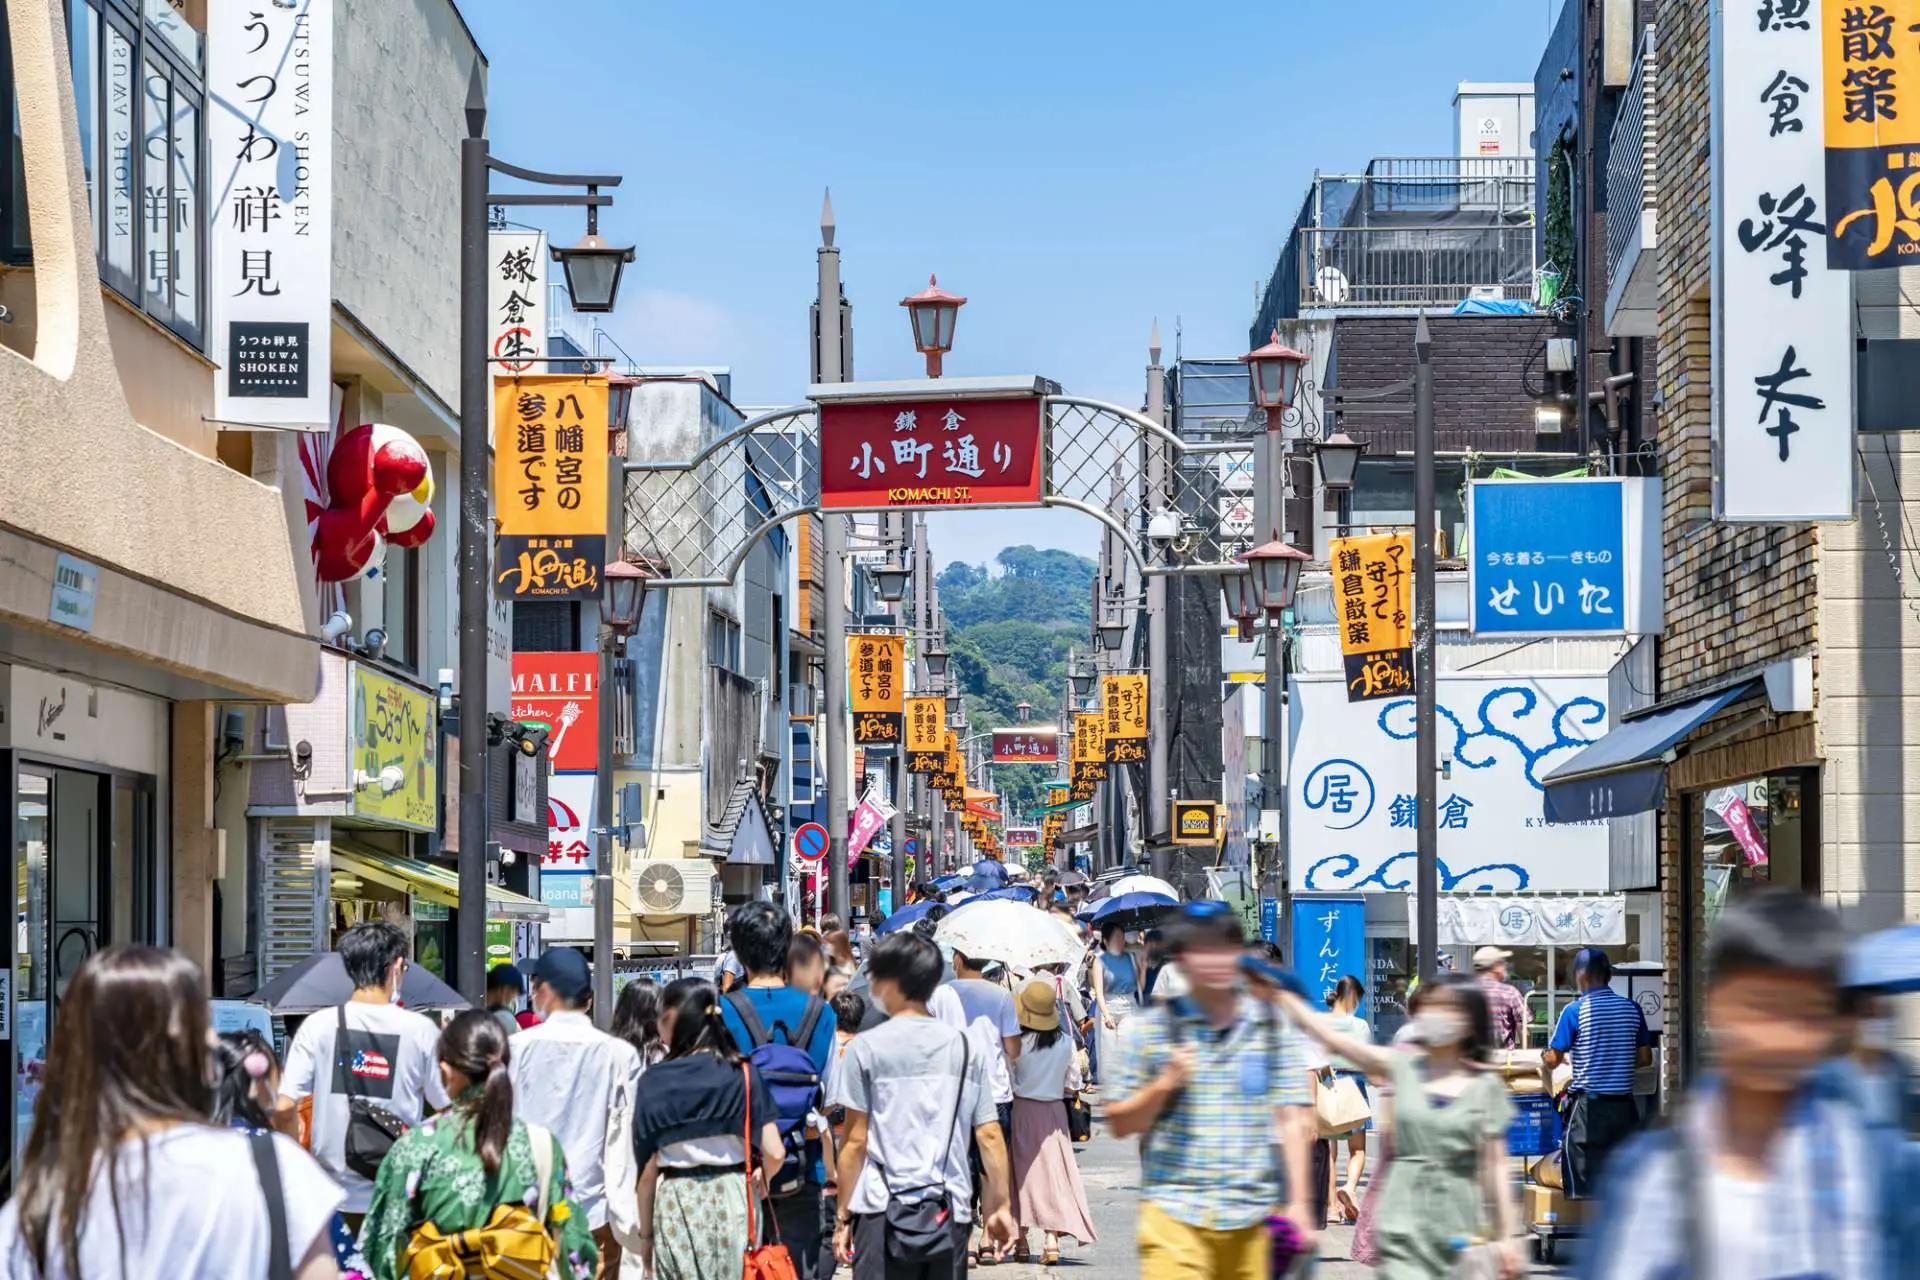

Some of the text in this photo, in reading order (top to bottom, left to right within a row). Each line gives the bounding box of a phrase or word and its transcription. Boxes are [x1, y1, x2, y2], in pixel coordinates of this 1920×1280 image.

[295, 13, 310, 236] UTSUWA SHOKEN
[232, 11, 282, 297] うつわ祥見
[239, 336, 299, 348] うつわ祥見
[239, 351, 299, 360] UTSUWA
[239, 363, 299, 374] SHOKEN
[893, 408, 966, 432] 鎌倉
[517, 392, 546, 511] 参道です
[555, 393, 585, 511] 八幡宮の
[849, 433, 1012, 480] 小町通り
[888, 486, 972, 501] KOMACHI ST.
[531, 587, 560, 595] KOMACHI
[1338, 549, 1370, 645] 鎌倉散策
[1366, 561, 1388, 620] 守って
[1385, 545, 1406, 629] マナーを
[1488, 578, 1614, 615] せいた
[859, 642, 874, 701] 参道です
[877, 642, 893, 701] 八幡宮の
[511, 703, 554, 718] itchen
[1132, 681, 1144, 728] マナーを
[1001, 743, 1049, 755] 小町通り
[1388, 793, 1475, 830] 鎌倉
